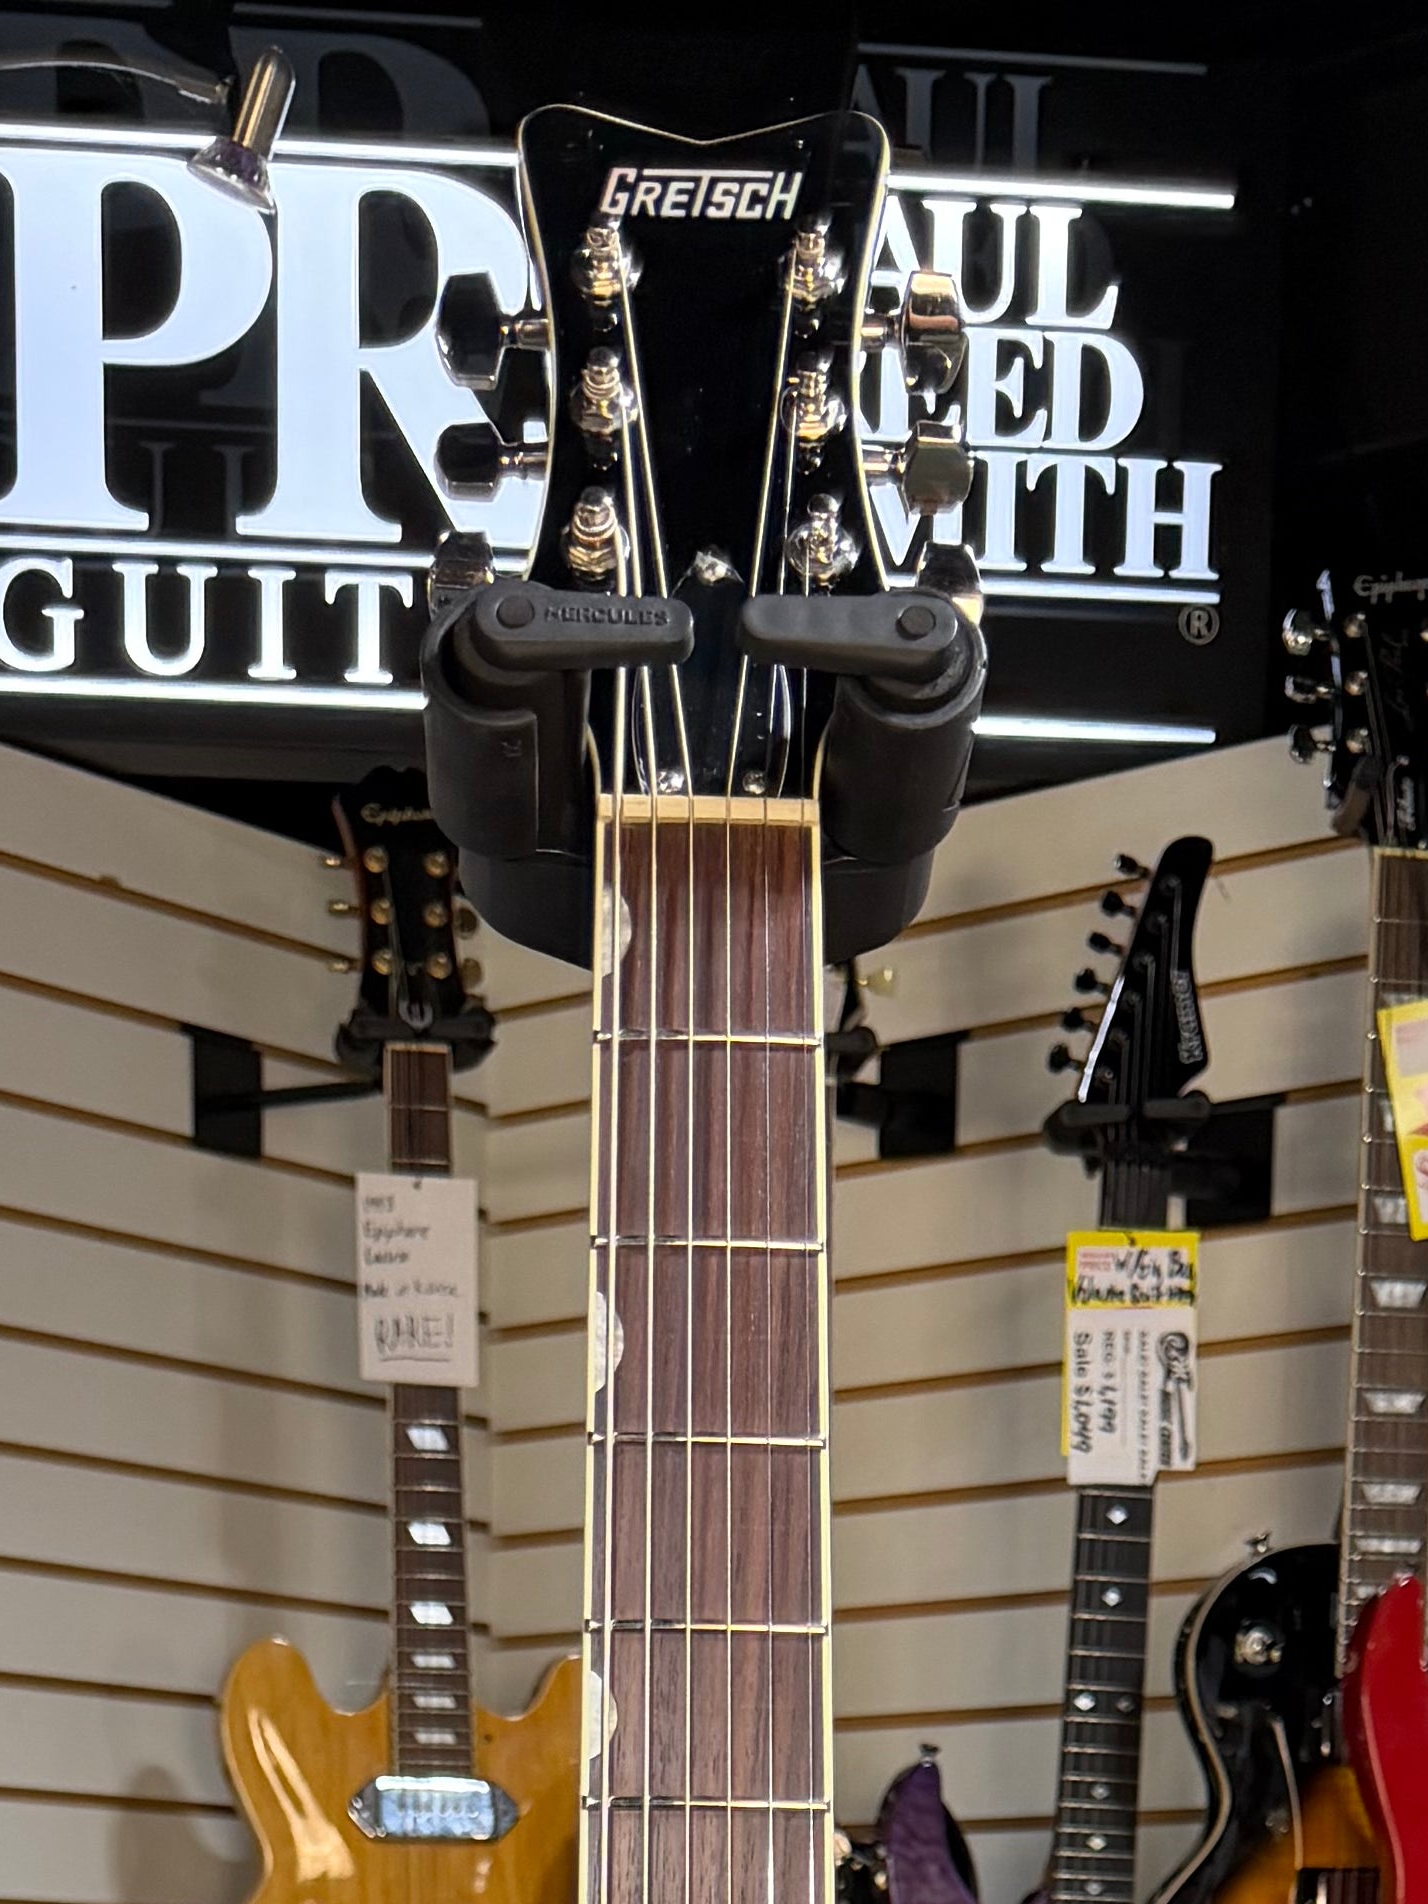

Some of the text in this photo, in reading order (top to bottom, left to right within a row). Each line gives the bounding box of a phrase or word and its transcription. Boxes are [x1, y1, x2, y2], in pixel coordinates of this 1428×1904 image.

[599, 167, 803, 220] GRETSCH
[864, 195, 1120, 330] AUL
[544, 606, 670, 627] HERCULES
[1074, 1330, 1093, 1378] Sale
